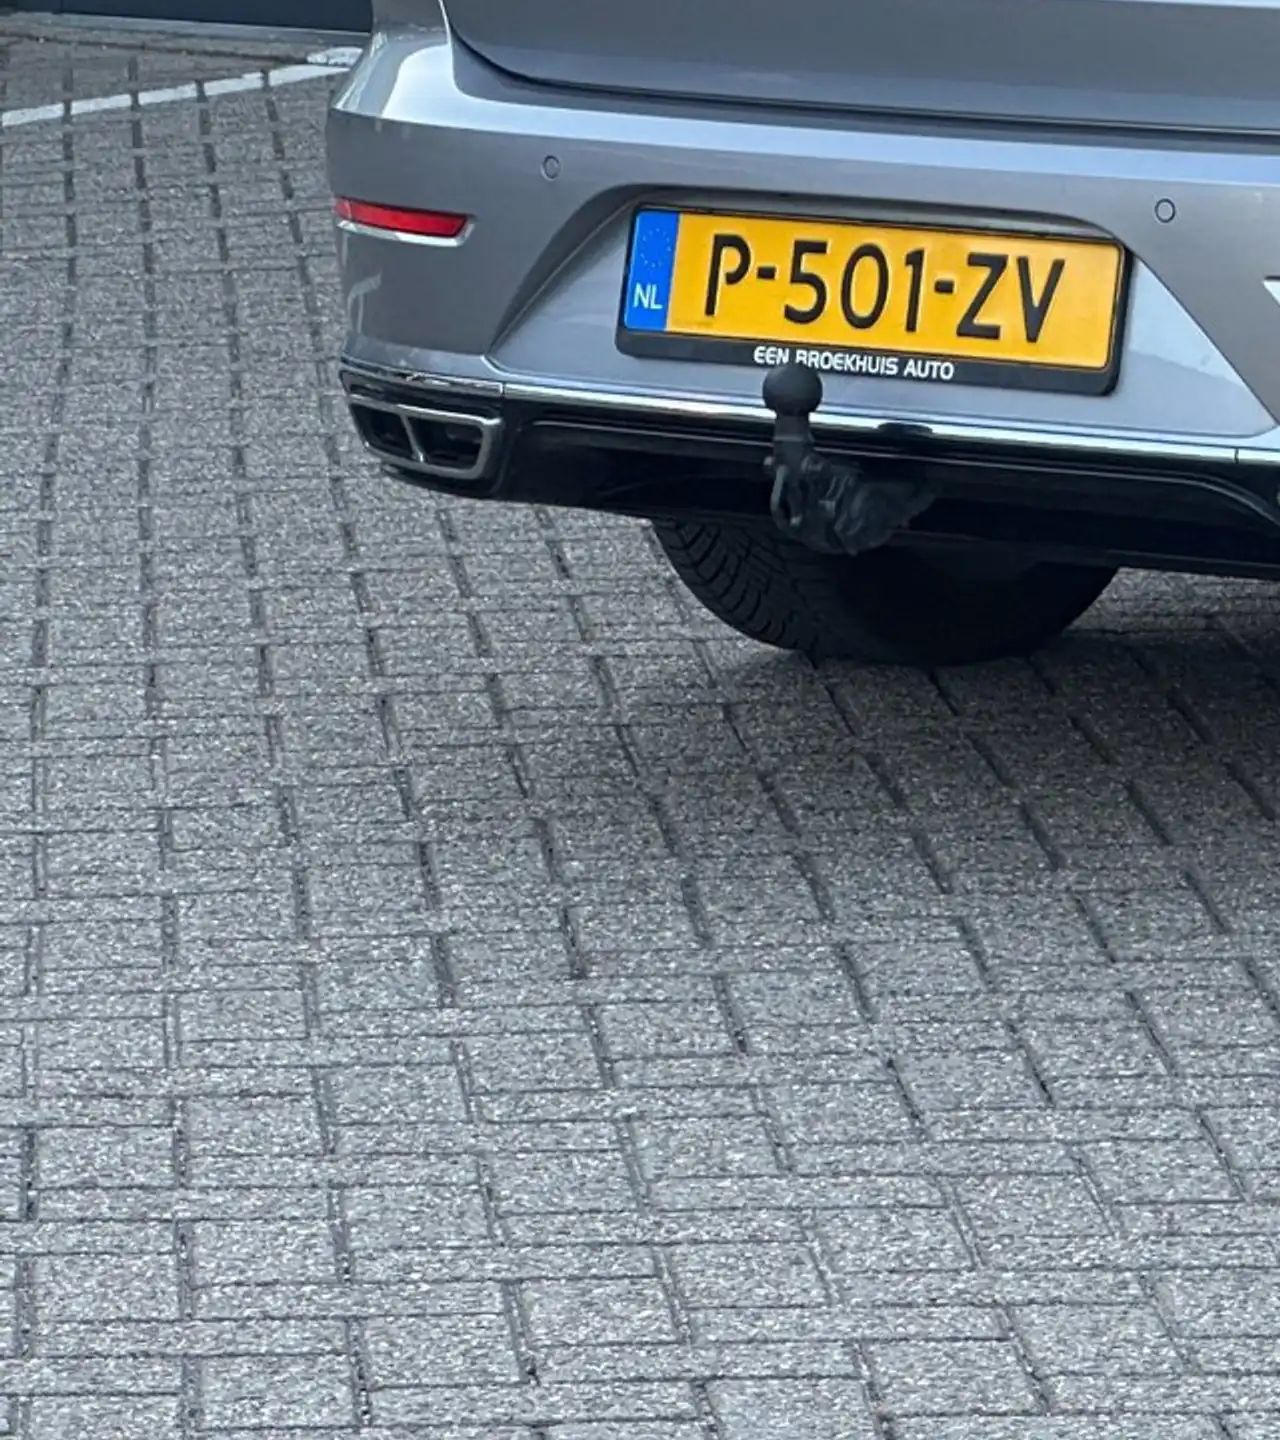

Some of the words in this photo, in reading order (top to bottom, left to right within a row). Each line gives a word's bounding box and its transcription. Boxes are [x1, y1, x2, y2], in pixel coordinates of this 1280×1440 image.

[633, 282, 663, 310] NL
[704, 233, 1064, 344] P-501-ZV
[753, 345, 790, 365] EEN
[795, 349, 899, 376] BROEKHUIS
[903, 359, 955, 380] AUTO
